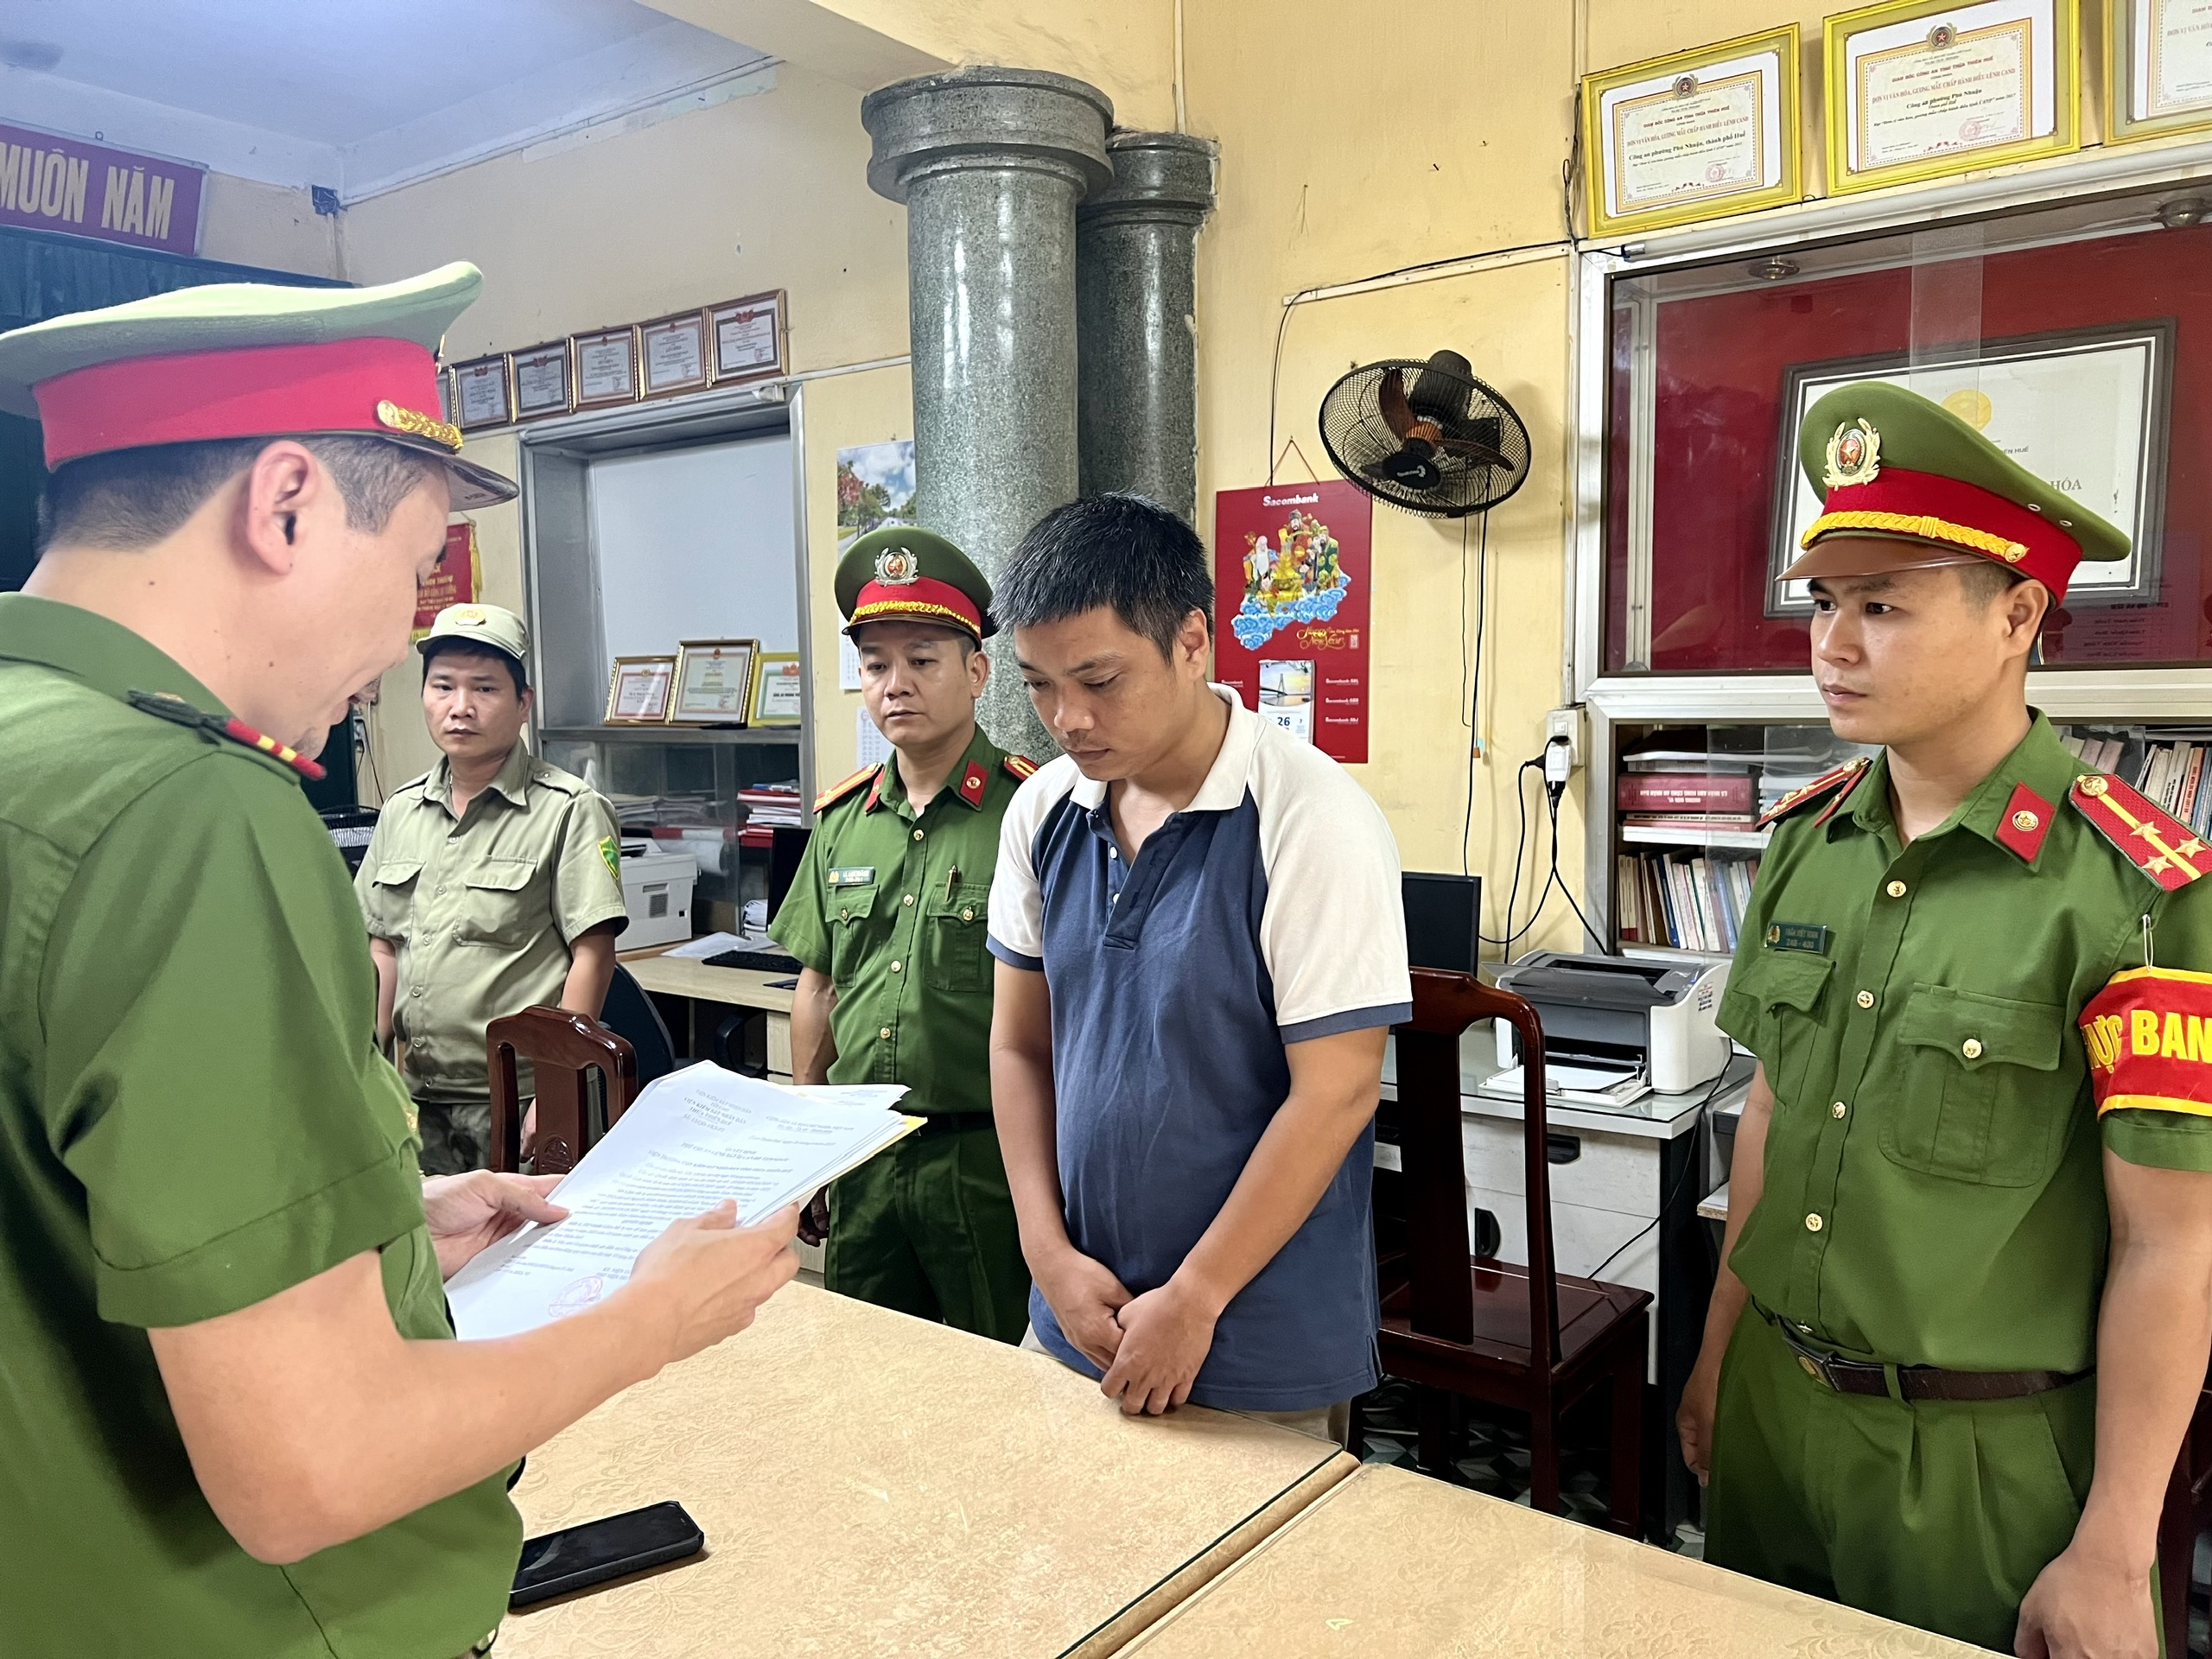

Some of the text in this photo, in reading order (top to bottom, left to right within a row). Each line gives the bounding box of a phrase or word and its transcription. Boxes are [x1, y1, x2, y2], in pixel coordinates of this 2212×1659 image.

[101, 165, 175, 240] NĂM
[2014, 445, 2029, 454] HUẾ
[1262, 493, 1319, 507] Sacombank
[1277, 716, 1290, 726] 26
[2131, 1009, 2212, 1064] BAN
